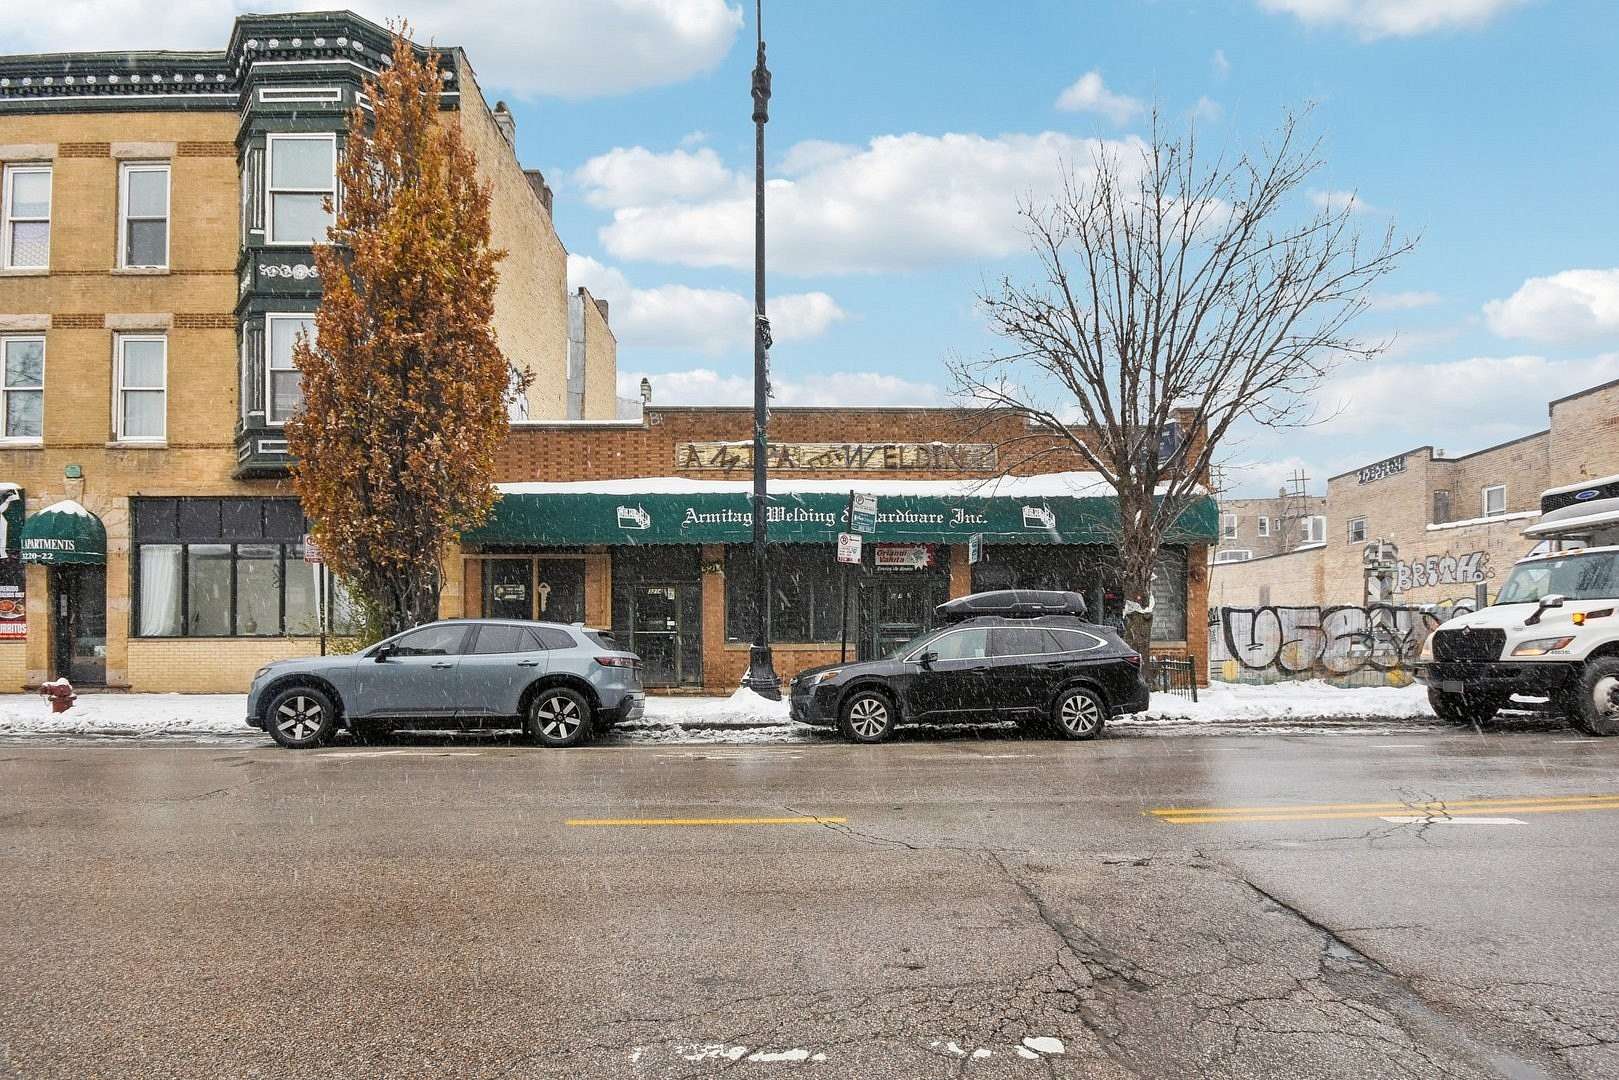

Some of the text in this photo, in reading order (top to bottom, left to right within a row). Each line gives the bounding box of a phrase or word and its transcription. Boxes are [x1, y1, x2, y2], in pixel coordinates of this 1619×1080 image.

[682, 507, 754, 529] Armitag
[766, 506, 836, 527] Welding
[876, 509, 944, 524] ardware
[949, 508, 988, 528] Inc.
